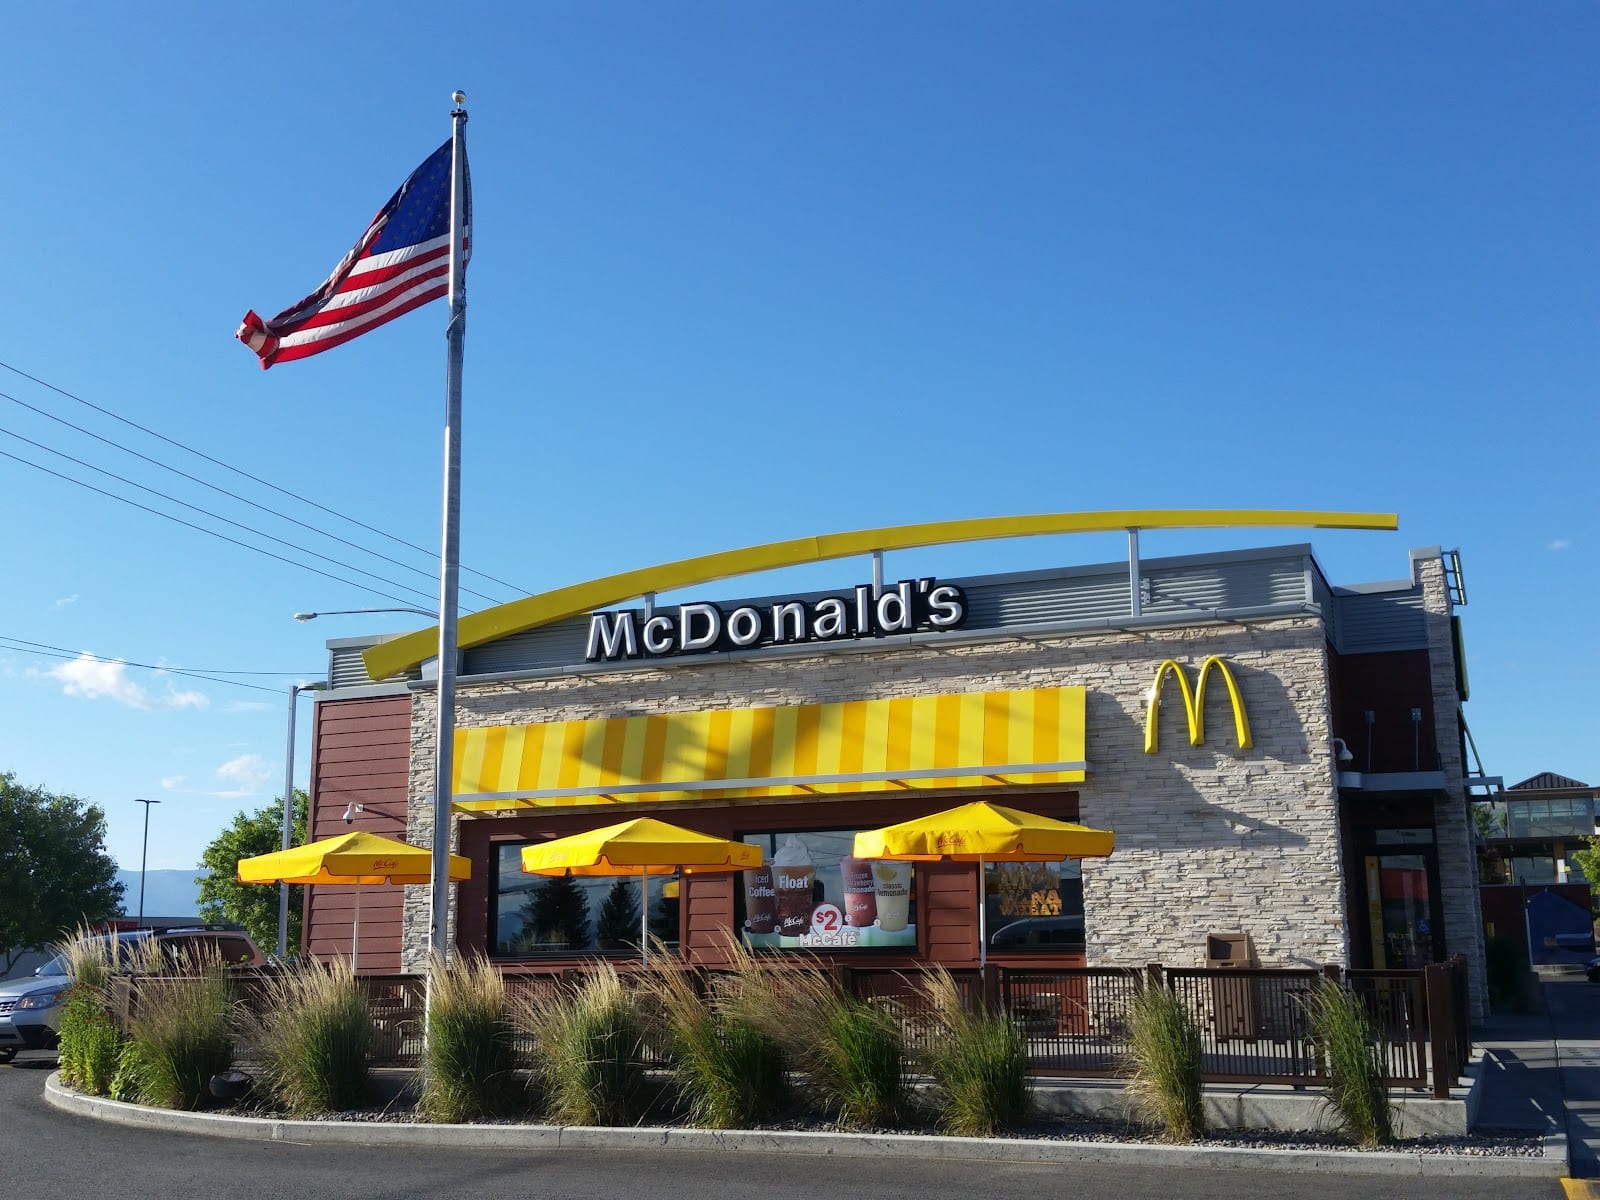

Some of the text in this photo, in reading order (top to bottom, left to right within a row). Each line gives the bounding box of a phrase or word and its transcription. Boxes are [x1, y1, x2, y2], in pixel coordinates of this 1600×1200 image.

[586, 578, 965, 661] McDonald's
[756, 874, 769, 883] Iced
[779, 875, 809, 889] Float
[749, 886, 775, 897] Coffee
[816, 910, 838, 931] $2
[800, 932, 856, 947] McCafé
